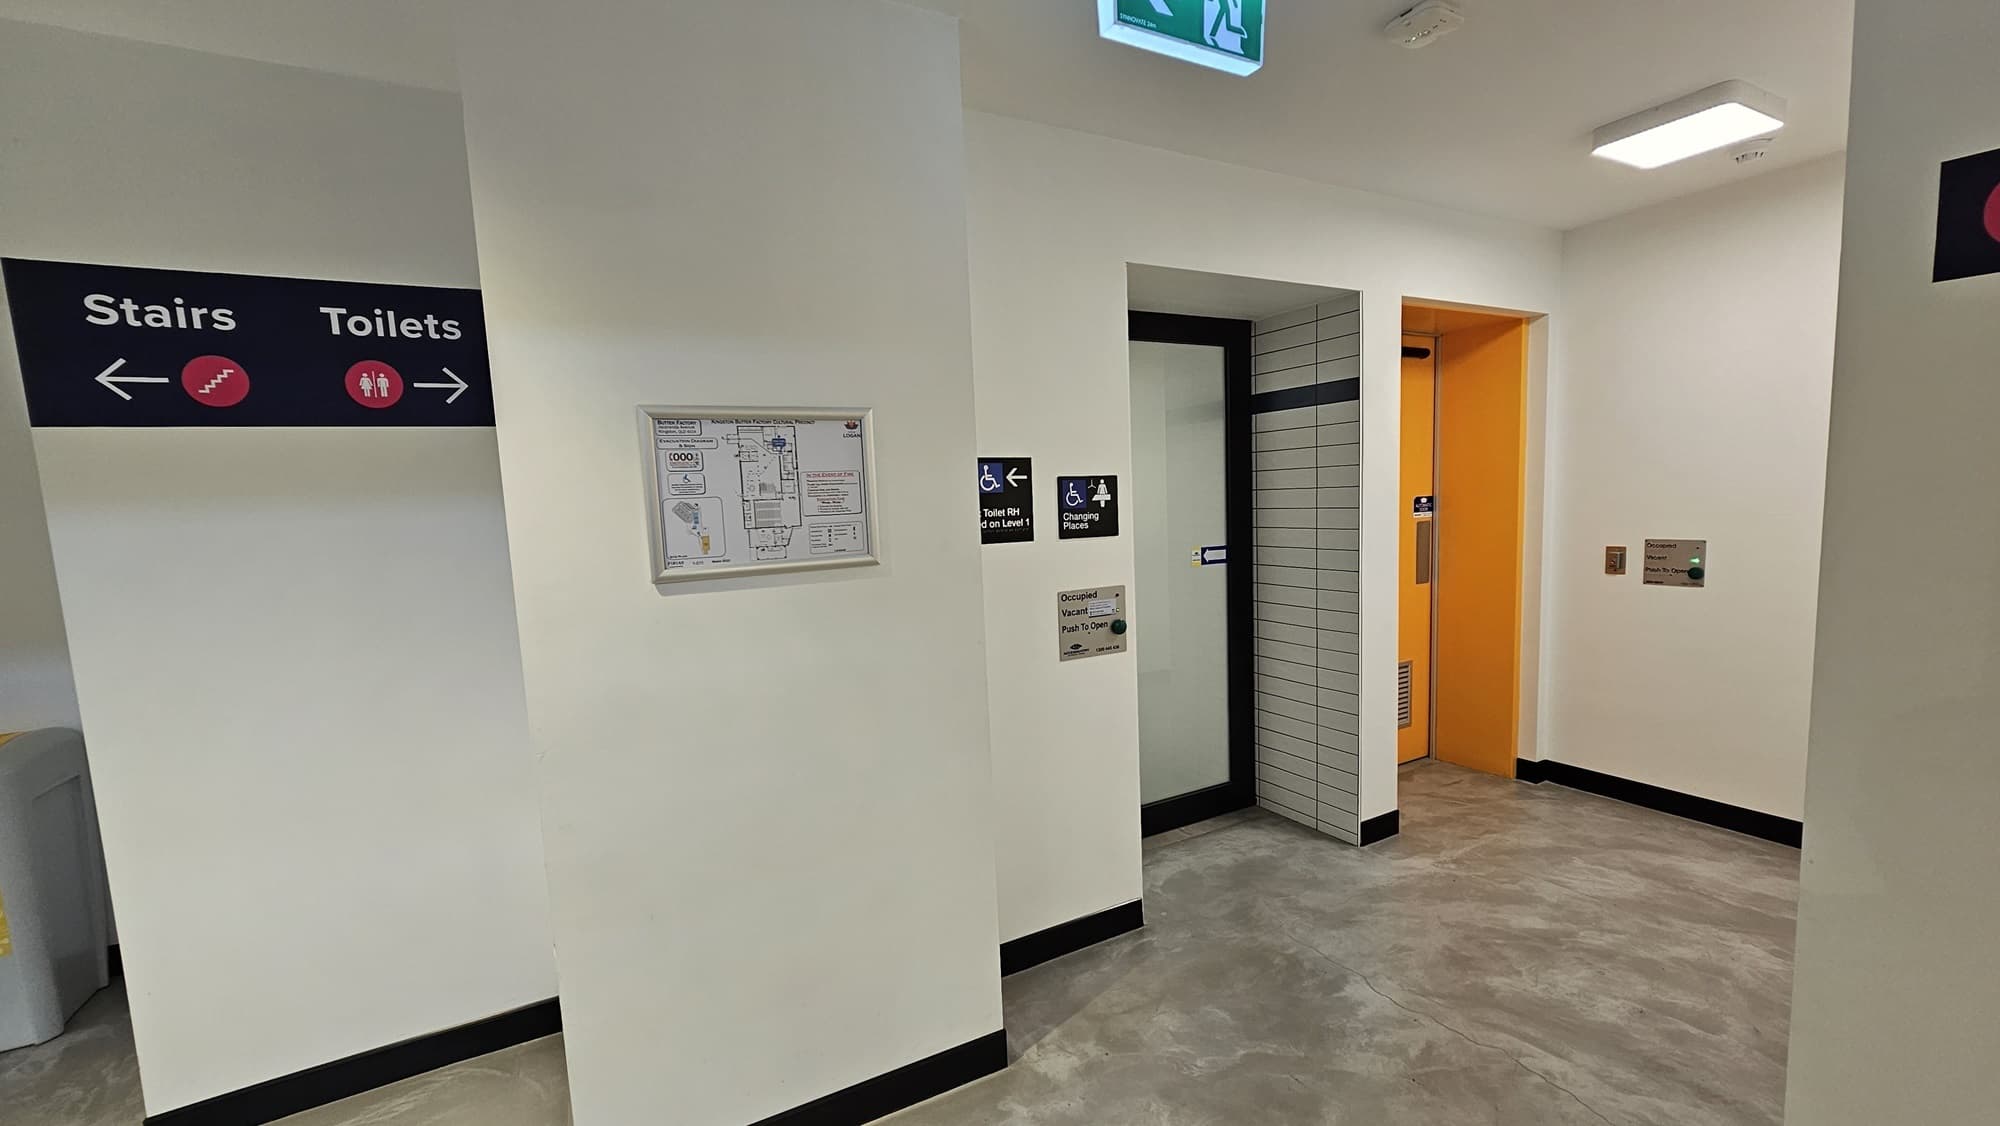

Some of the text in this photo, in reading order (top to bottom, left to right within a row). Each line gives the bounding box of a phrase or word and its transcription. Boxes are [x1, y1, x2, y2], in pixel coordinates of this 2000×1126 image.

[82, 292, 237, 332] Stairs
[319, 305, 463, 341] Toilets
[983, 508, 1006, 518] Toilet
[1007, 507, 1020, 517] RH
[1063, 511, 1100, 522] Changing
[989, 520, 1001, 529] on
[1002, 518, 1024, 528] Level
[1025, 517, 1030, 527] 1
[1063, 521, 1089, 530] Places
[1061, 590, 1098, 602] Occupied
[1061, 607, 1089, 617] Vacant
[1061, 621, 1109, 634] Push To Open
